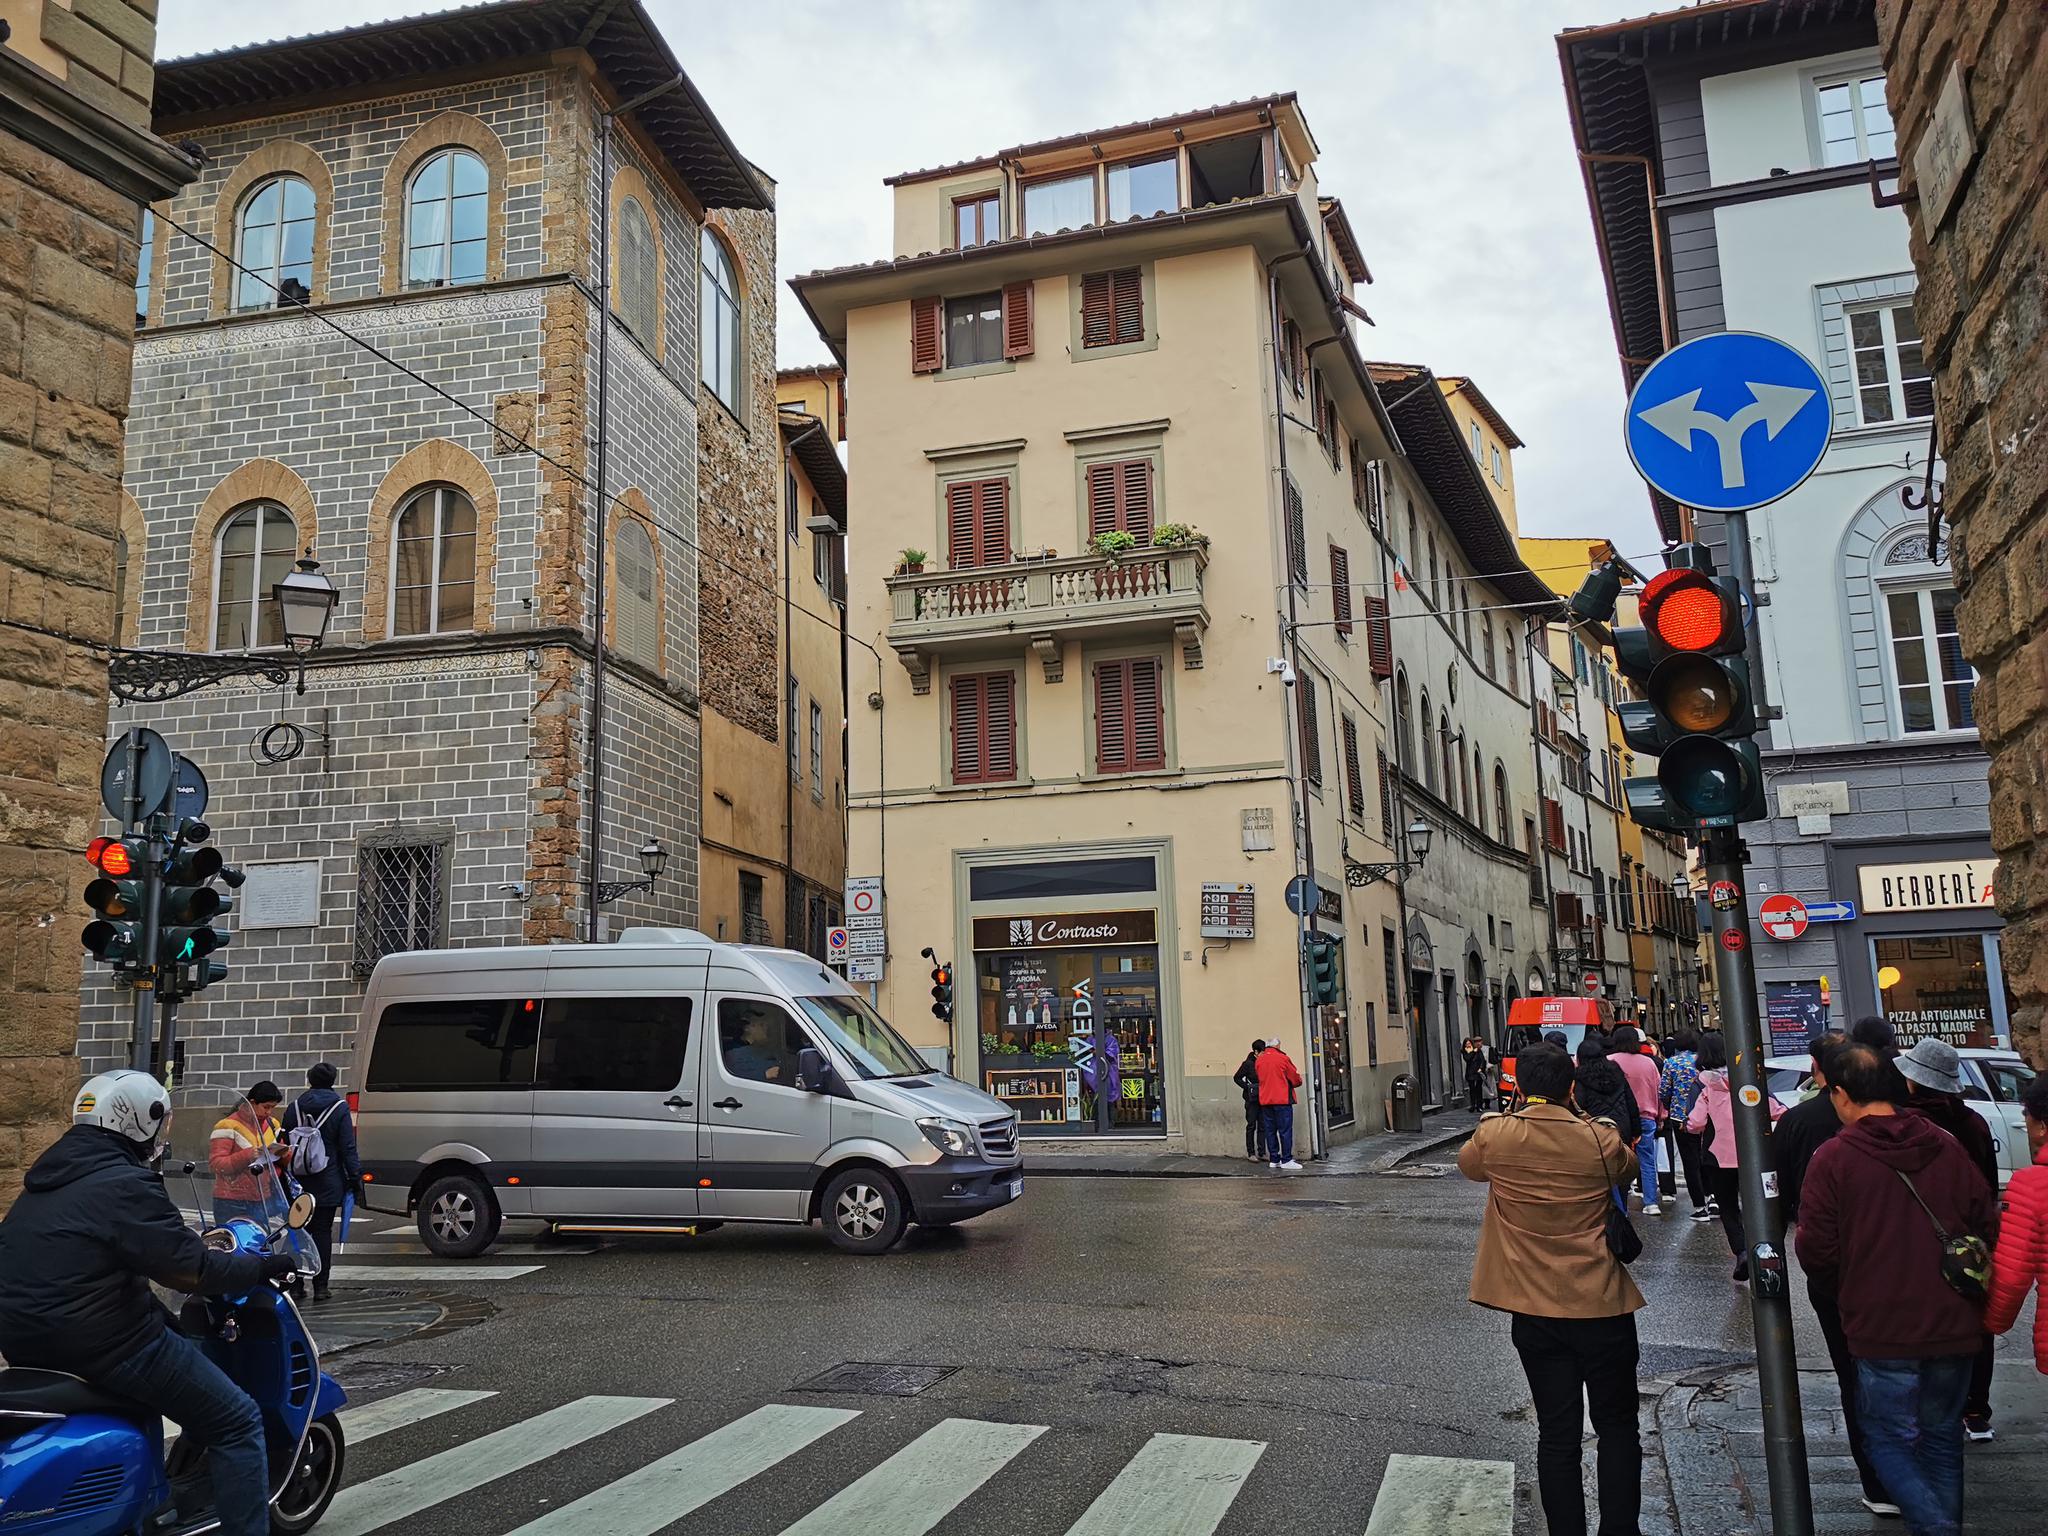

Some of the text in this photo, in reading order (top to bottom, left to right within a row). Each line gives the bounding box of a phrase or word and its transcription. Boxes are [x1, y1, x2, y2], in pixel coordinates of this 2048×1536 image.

[1882, 864, 1977, 907] BERBERÈ
[1037, 920, 1118, 942] Contrasto
[1072, 977, 1095, 1074] AVEDA
[1888, 1008, 1986, 1022] PIZZA ARTIGIANALE
[1906, 1023, 1938, 1034] PASTA
[1940, 1021, 1977, 1033] MADRE
